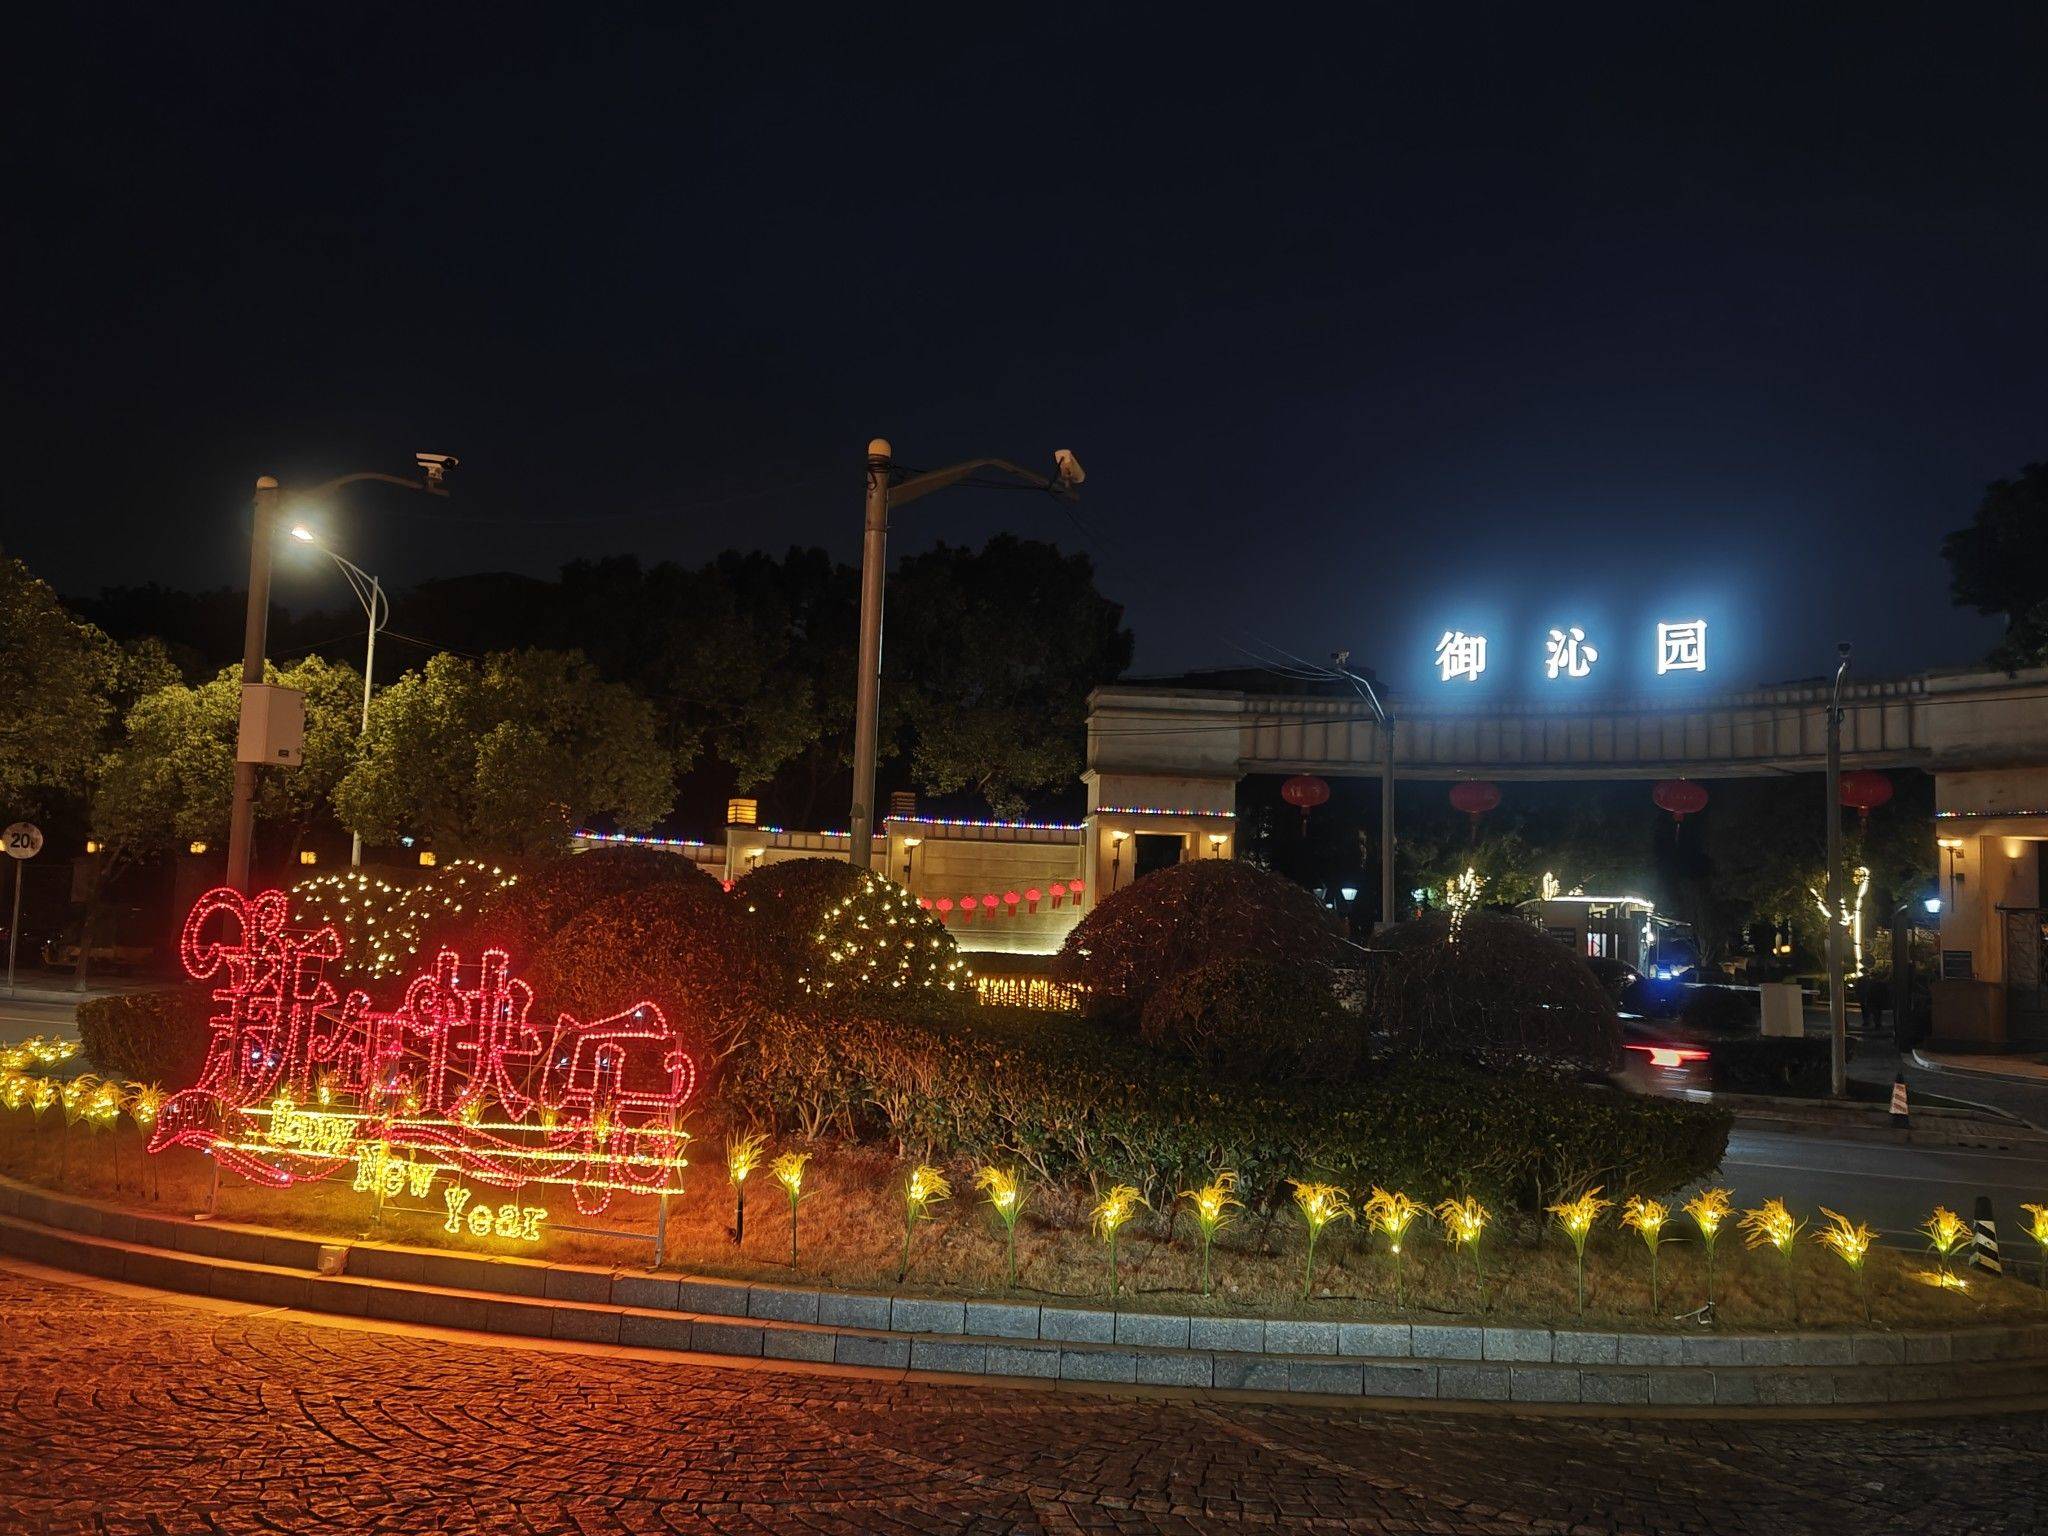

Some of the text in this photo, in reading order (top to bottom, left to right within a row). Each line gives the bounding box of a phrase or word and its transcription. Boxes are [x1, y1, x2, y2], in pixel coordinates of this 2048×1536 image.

[1435, 619, 1708, 682] 御沁园
[181, 887, 694, 1214] 新年快乐
[353, 1143, 438, 1197] New
[444, 1186, 547, 1240] Year
